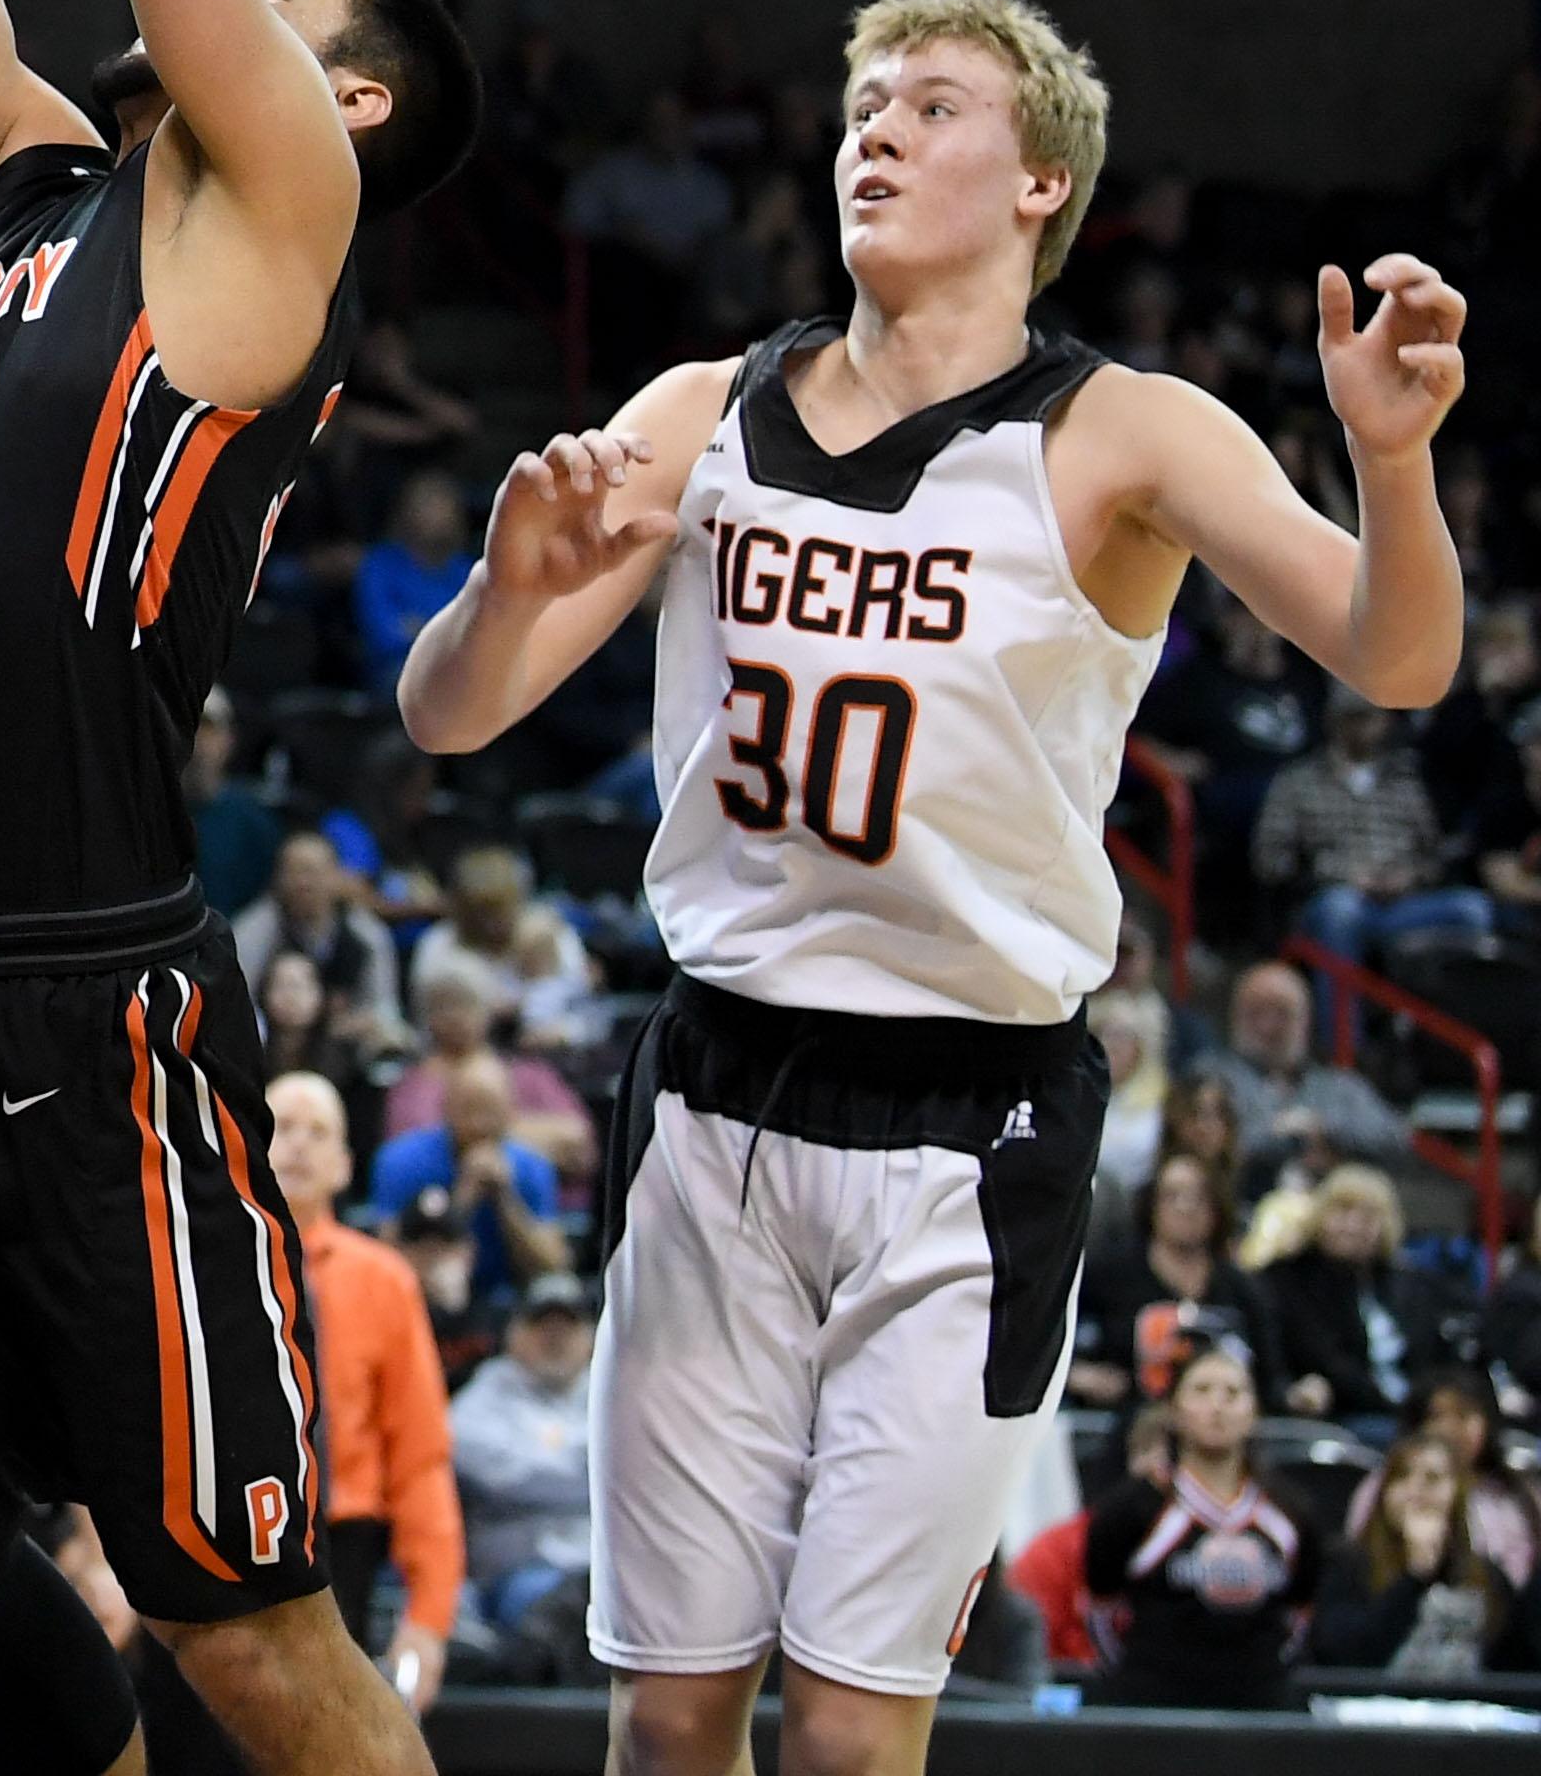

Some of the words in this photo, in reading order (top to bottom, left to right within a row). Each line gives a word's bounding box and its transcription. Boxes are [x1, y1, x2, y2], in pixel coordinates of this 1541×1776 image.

[701, 516, 973, 644] IGERS
[713, 656, 918, 867] 30
[243, 1475, 289, 1565] P
